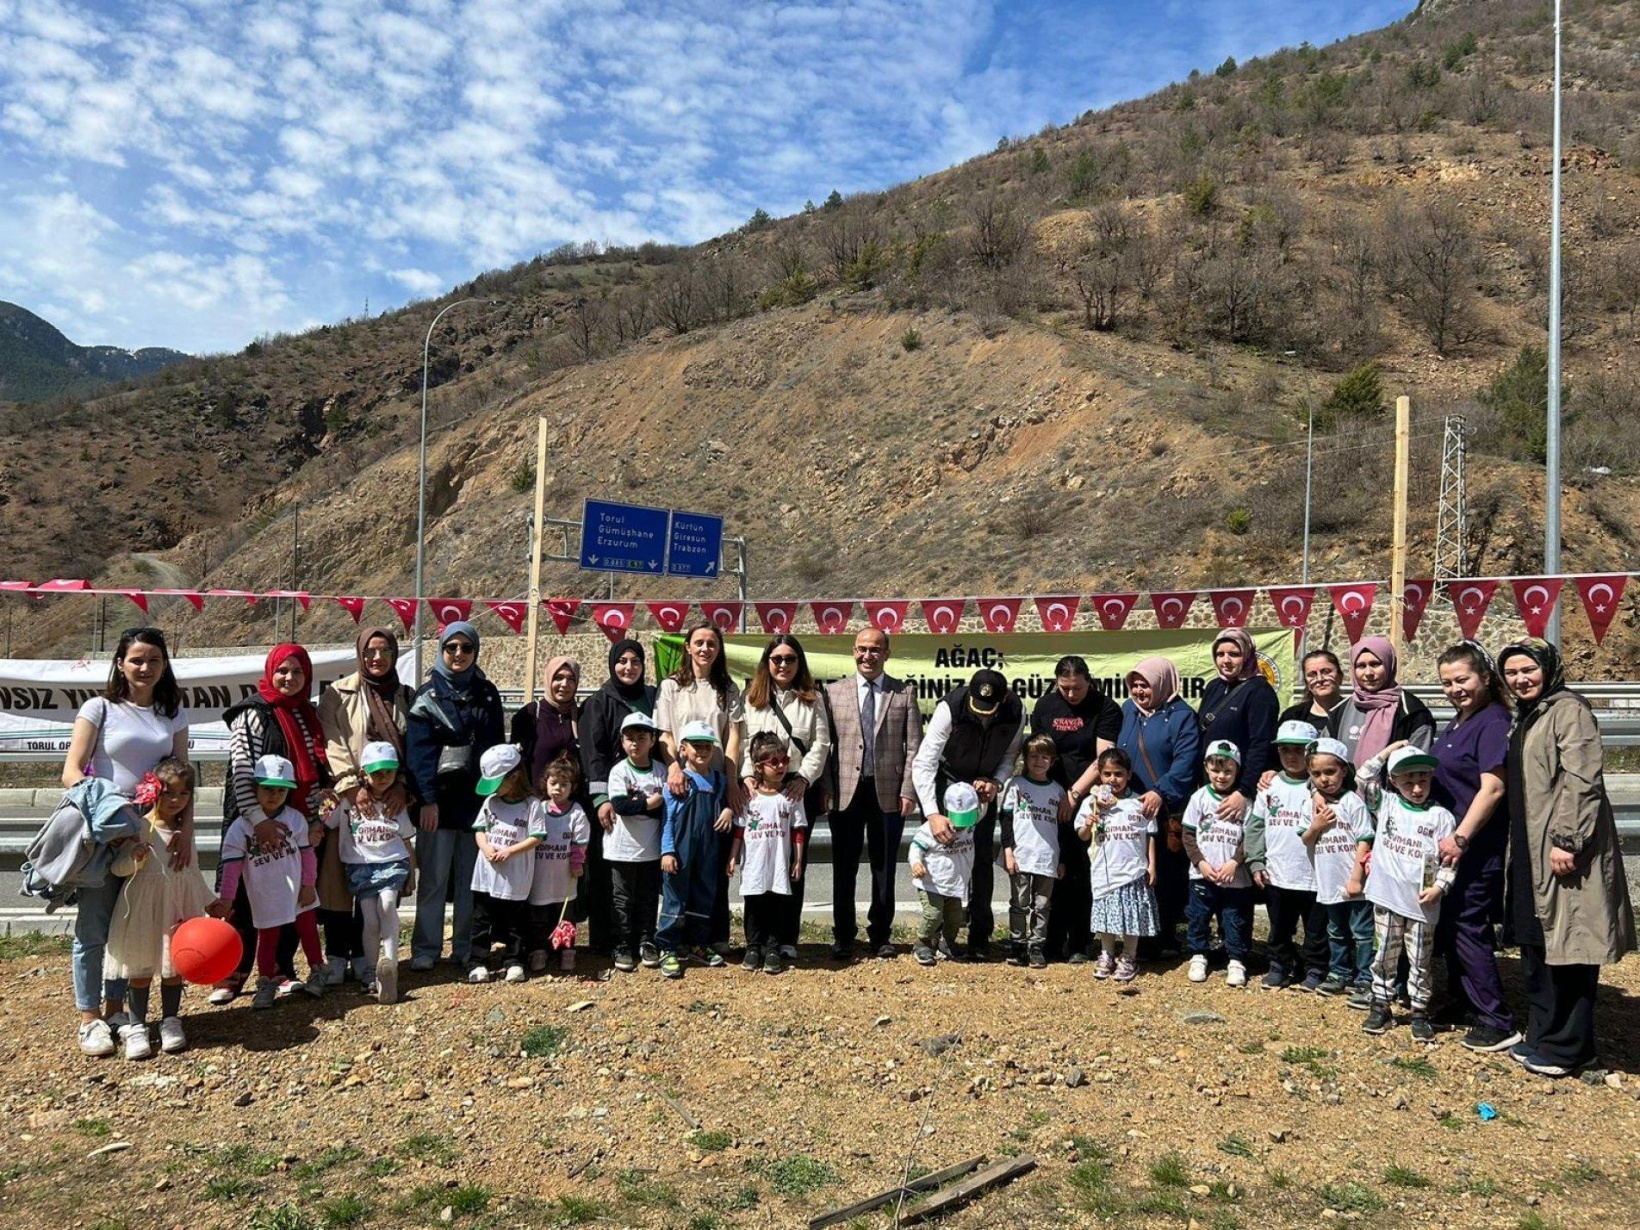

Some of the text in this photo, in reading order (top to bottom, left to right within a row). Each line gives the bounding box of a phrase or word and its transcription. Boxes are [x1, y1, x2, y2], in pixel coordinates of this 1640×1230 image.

[600, 513, 625, 524] Torul
[598, 524, 654, 539] Gümüşhane
[674, 521, 704, 532] Kürtün
[597, 536, 638, 549] Erzurum
[674, 532, 706, 543] Giresun
[674, 543, 707, 554] Trabzon
[935, 643, 1004, 670] AĞAÇ;
[1012, 673, 1057, 698] GÜZ
[27, 741, 56, 750] TORUL
[1278, 810, 1302, 819] ORMA
[1326, 845, 1336, 853] VE
[254, 855, 270, 867] SEV
